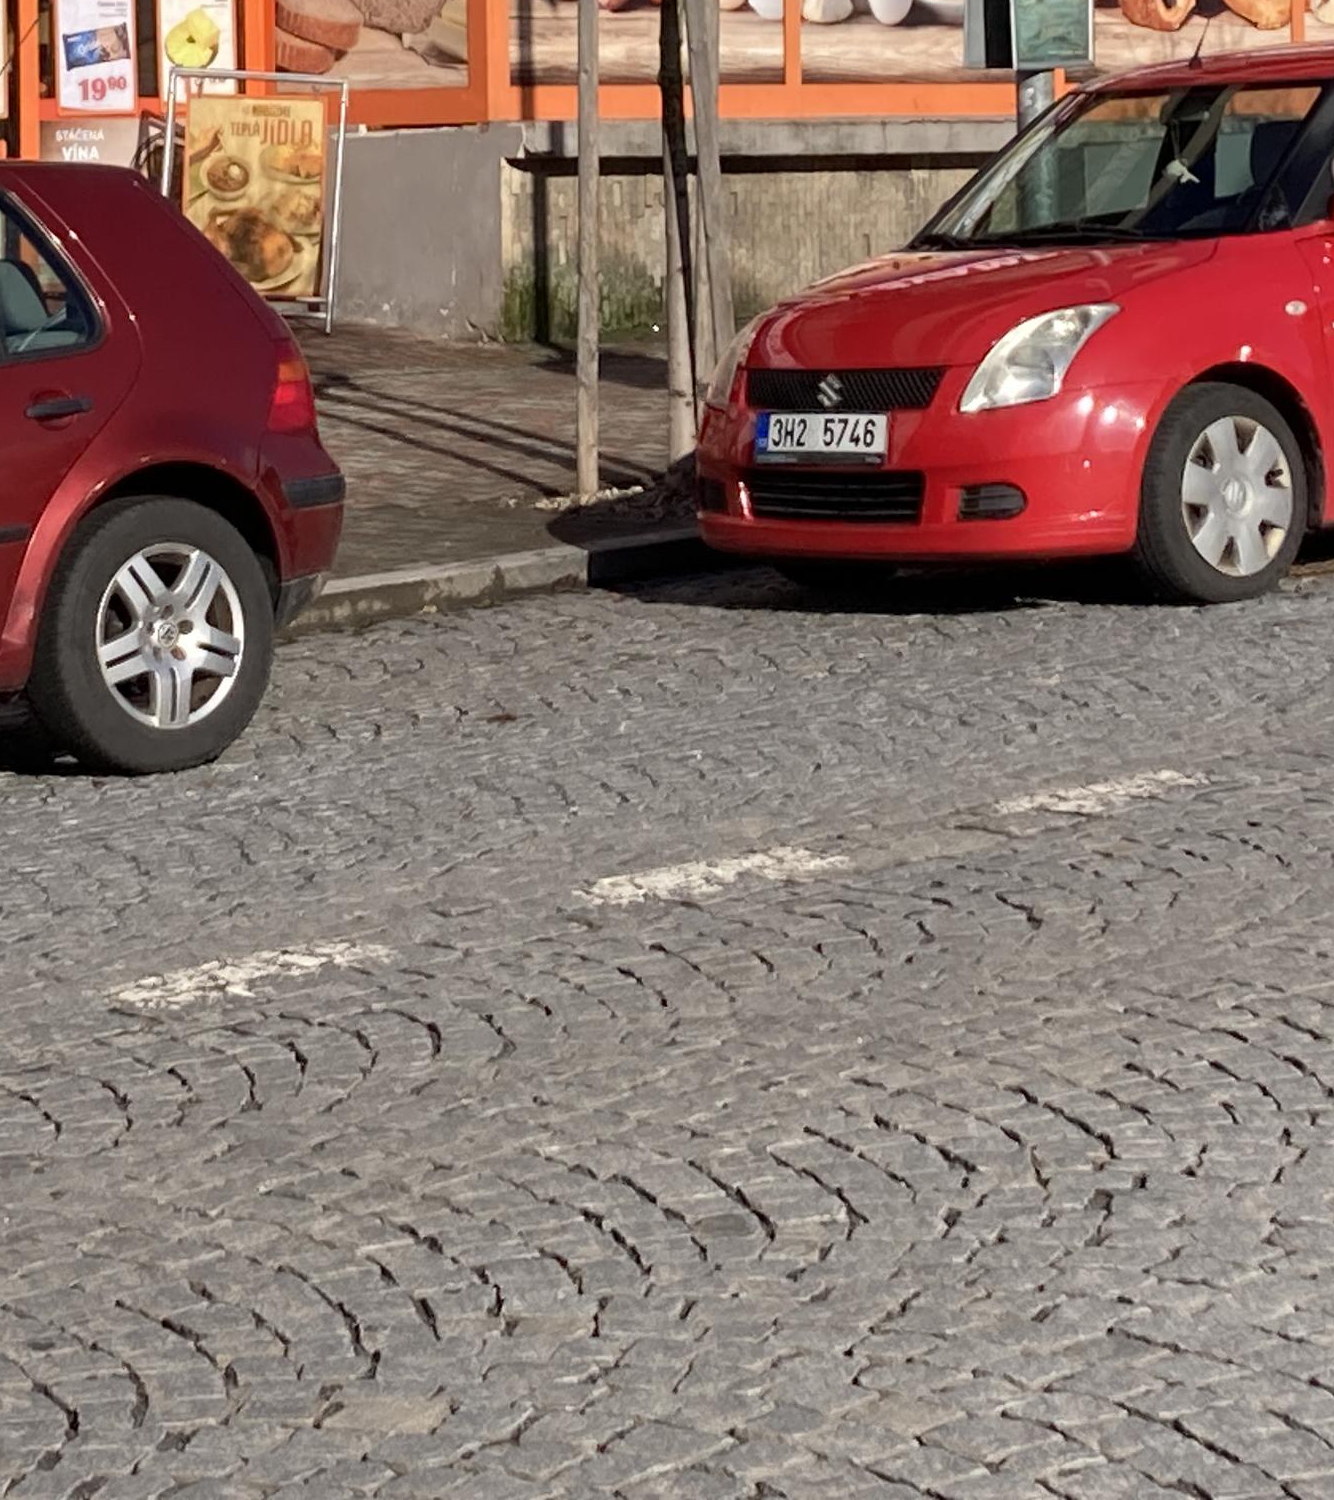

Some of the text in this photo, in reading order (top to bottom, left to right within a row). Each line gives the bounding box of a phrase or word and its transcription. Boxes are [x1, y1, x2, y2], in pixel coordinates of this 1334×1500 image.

[61, 142, 100, 161] VÍNA
[771, 418, 876, 448] 3H2 5746
